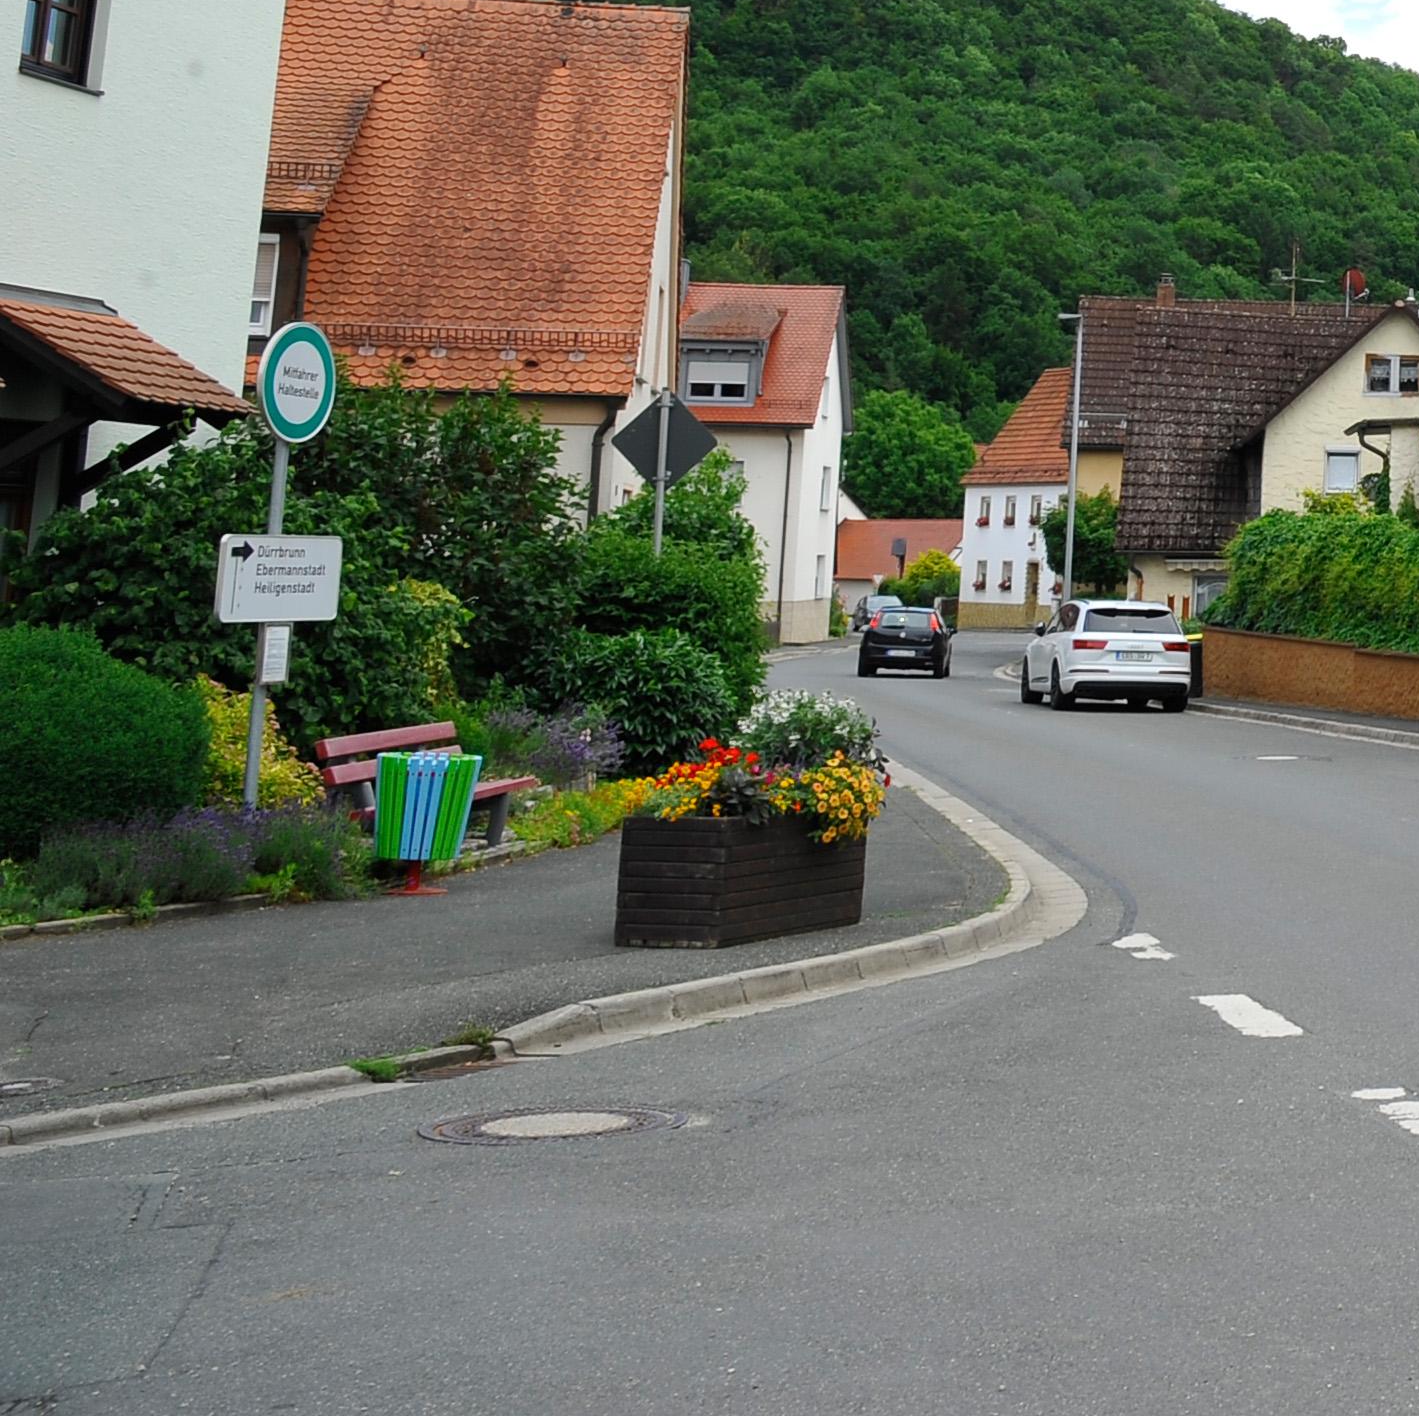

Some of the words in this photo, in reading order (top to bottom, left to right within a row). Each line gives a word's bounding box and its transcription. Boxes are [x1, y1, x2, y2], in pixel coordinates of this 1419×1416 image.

[283, 366, 319, 381] Mitfahrer
[278, 383, 319, 399] Haltestelle
[257, 545, 306, 558] Dürrbrunn
[256, 563, 326, 576] Ebermannstadt
[254, 581, 315, 597] Heiligenstadt
